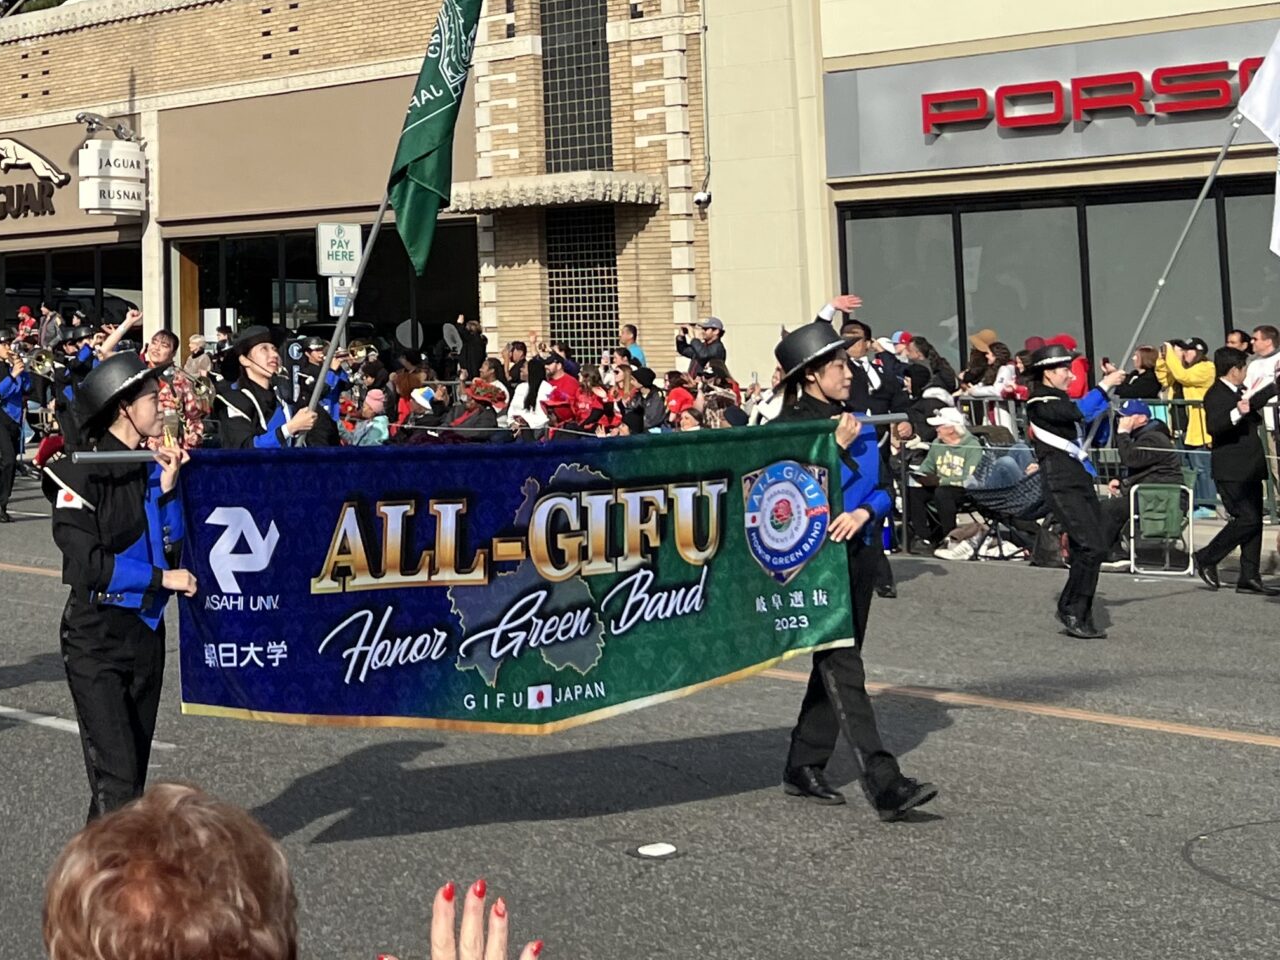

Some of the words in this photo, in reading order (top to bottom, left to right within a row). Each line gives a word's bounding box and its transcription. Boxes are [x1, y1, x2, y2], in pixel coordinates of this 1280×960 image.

[99, 158, 141, 170] JAGUAR
[99, 189, 142, 201] RUSNAK
[330, 239, 350, 250] PAY
[327, 250, 355, 261] HERE
[311, 478, 728, 594] ALL-GIFU
[771, 540, 803, 566] GREEN
[802, 520, 822, 552] BAND
[204, 594, 244, 611] ASAHI
[318, 605, 448, 685] Honor
[459, 589, 593, 659] Green
[601, 564, 709, 636] Band
[775, 615, 809, 631] 2023
[463, 691, 524, 711] GIFU
[554, 680, 607, 704] JAPAN
